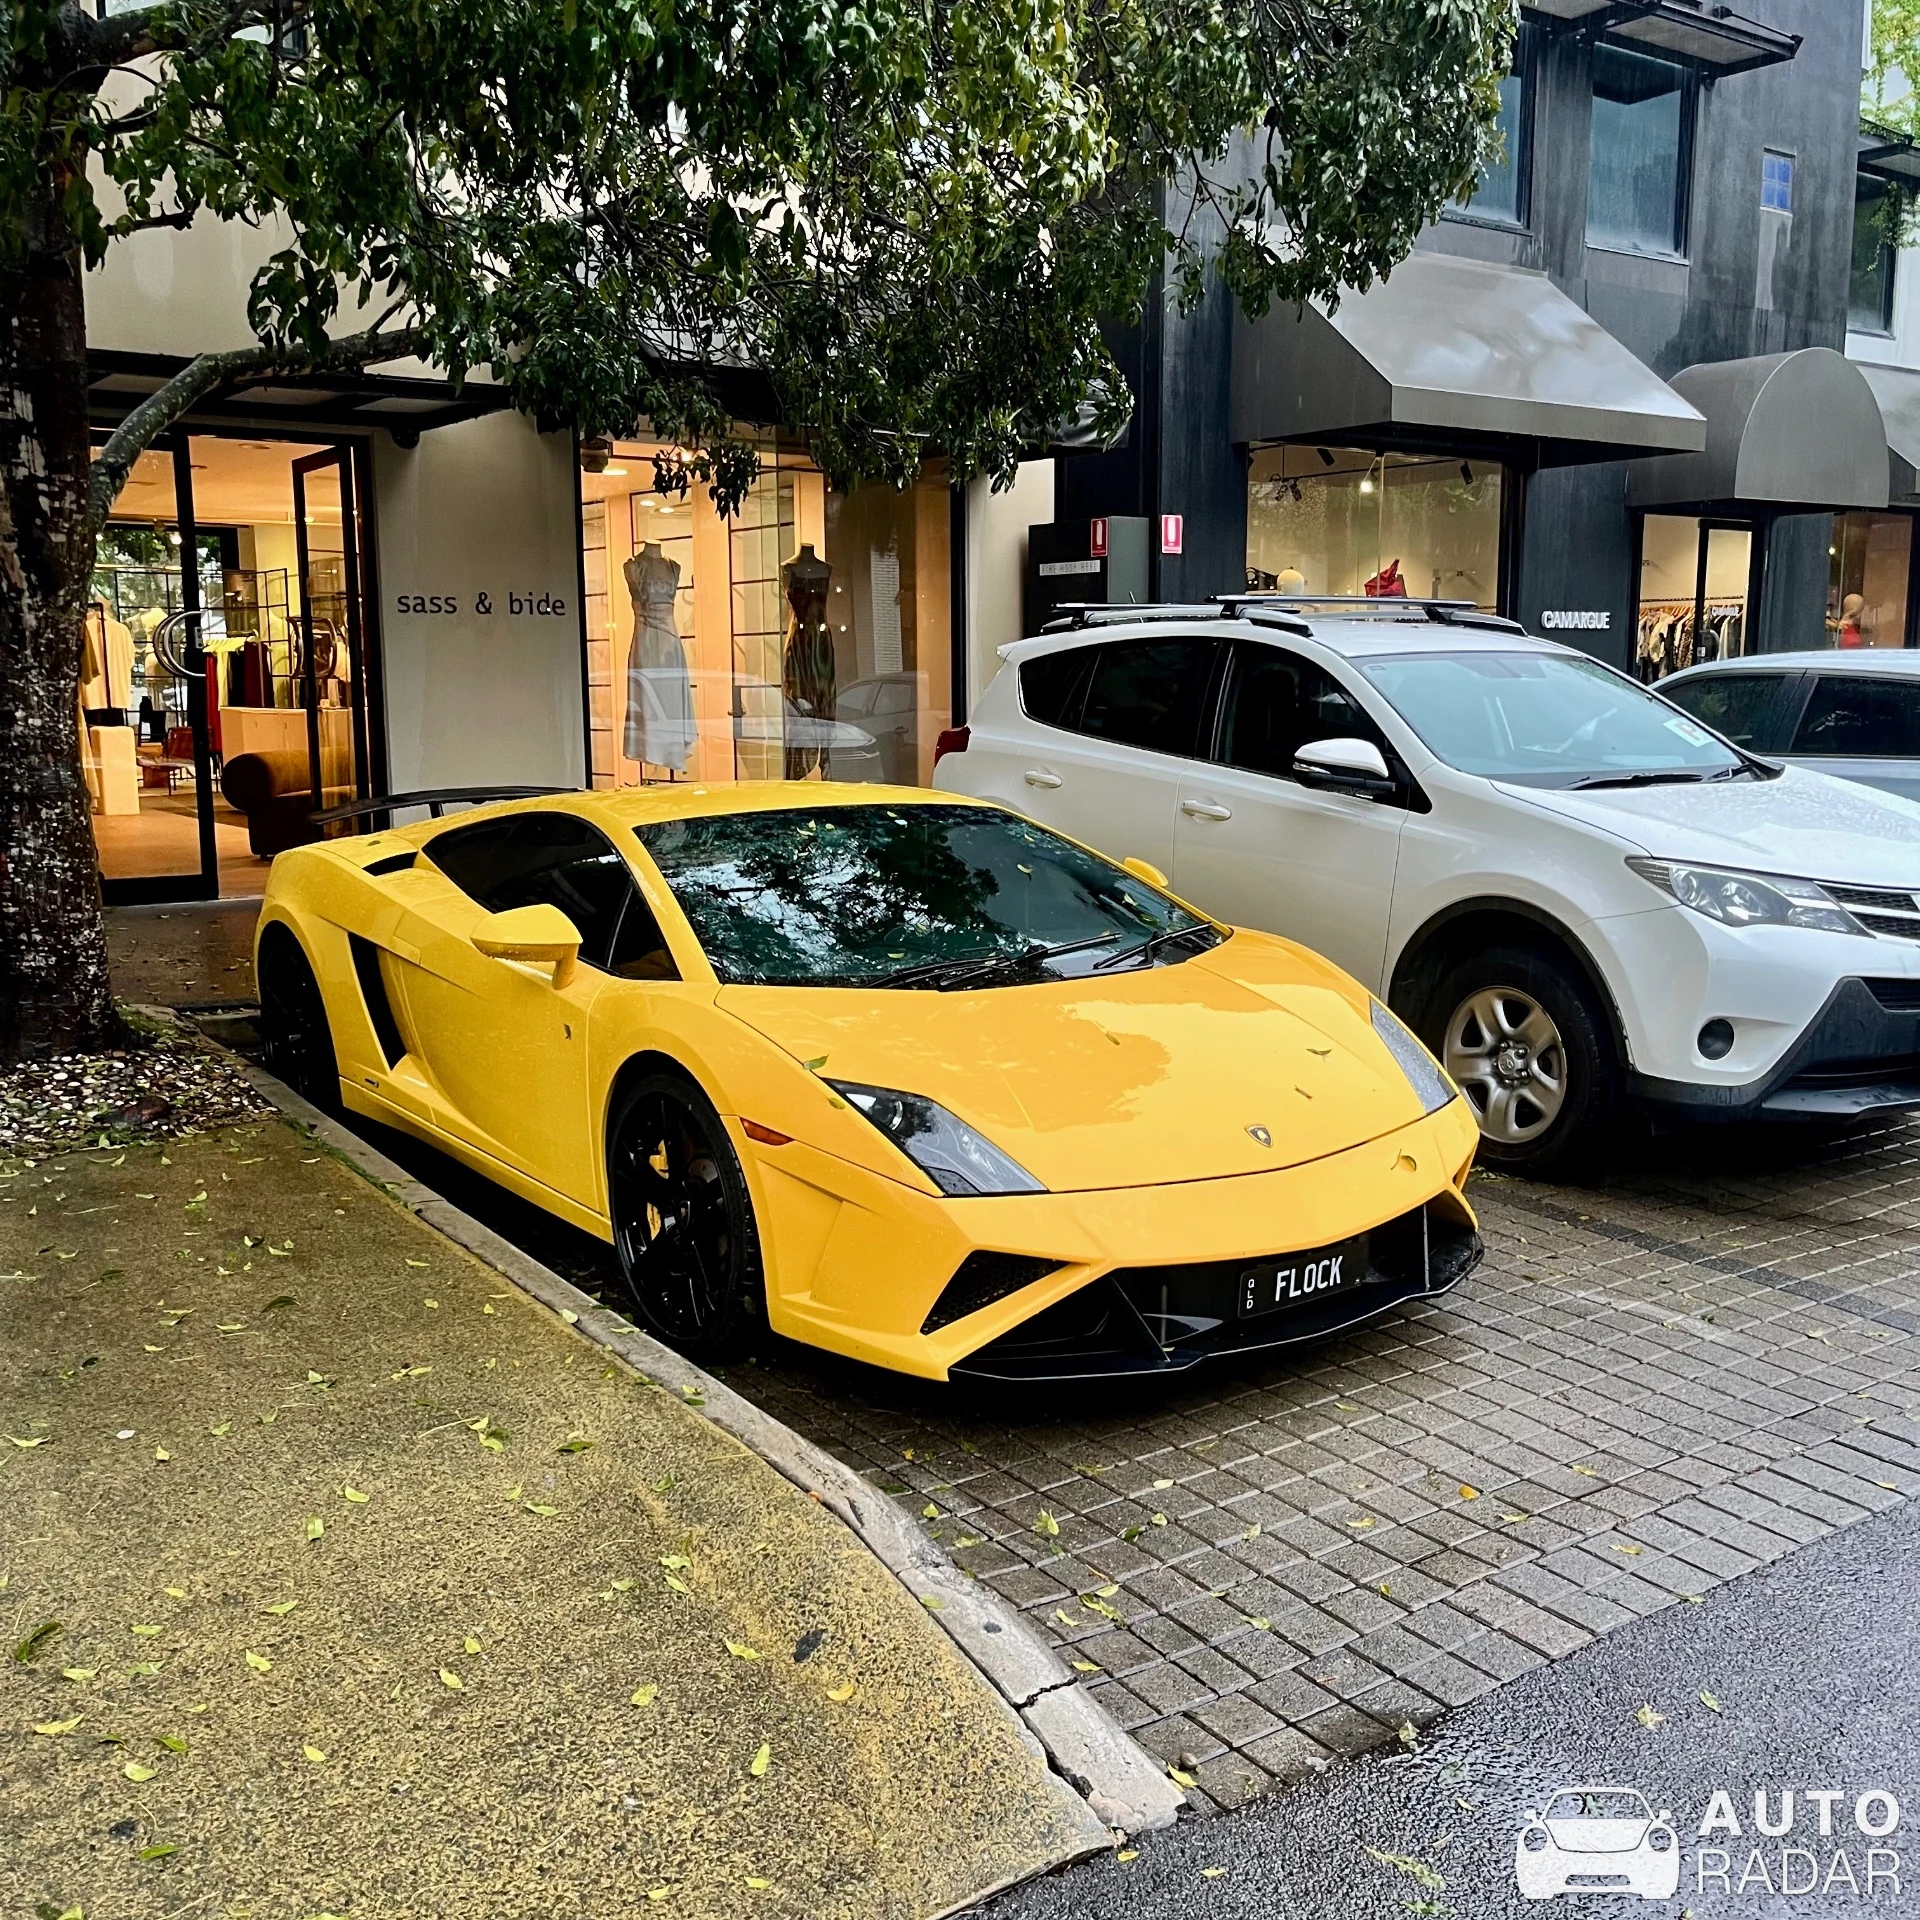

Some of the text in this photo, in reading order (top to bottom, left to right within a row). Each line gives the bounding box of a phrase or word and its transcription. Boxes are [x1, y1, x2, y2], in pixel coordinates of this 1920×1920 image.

[397, 591, 567, 616] sass & bide
[1541, 610, 1611, 629] CAMARGUE
[1275, 1255, 1343, 1301] FLOCK
[1246, 1278, 1255, 1309] QLD
